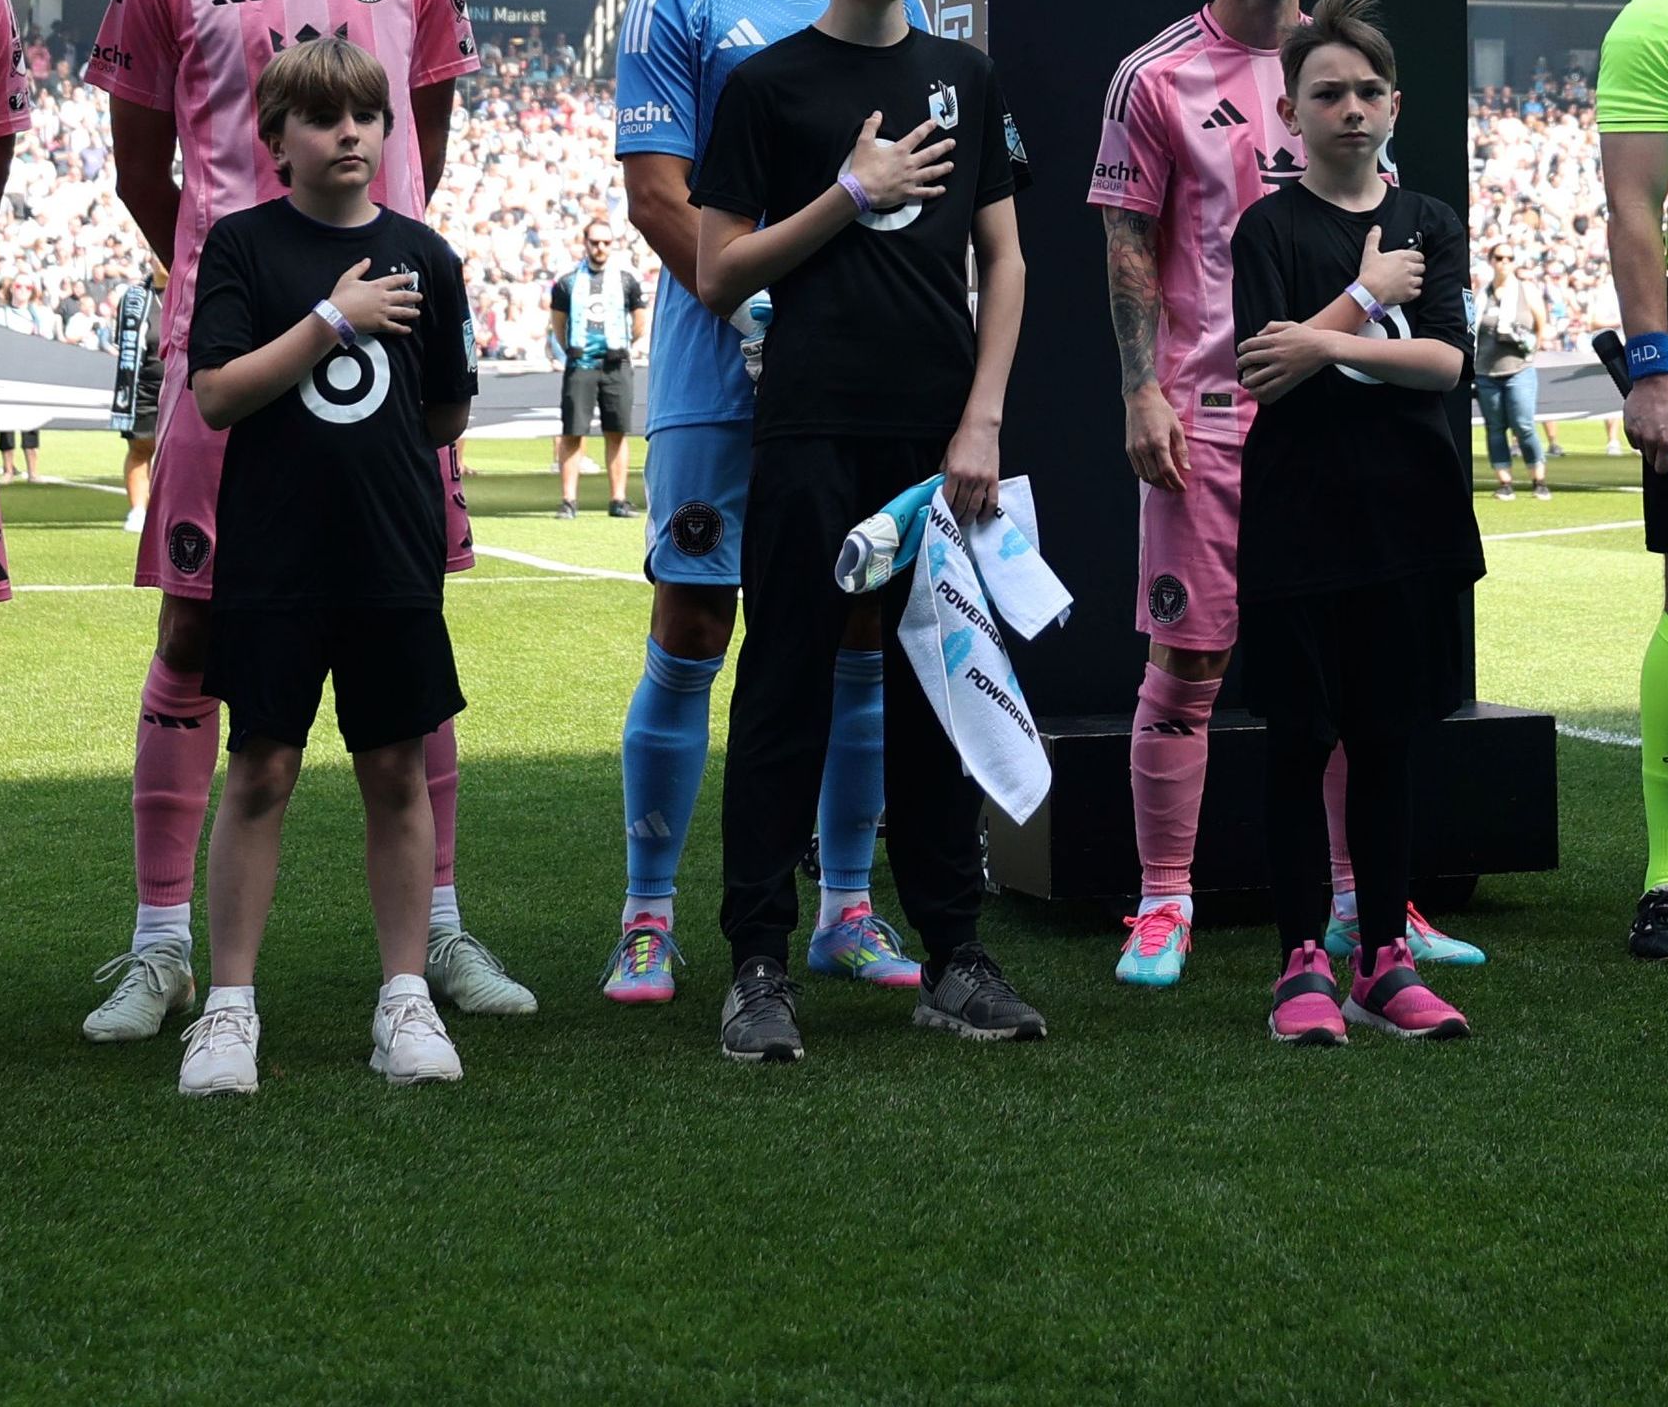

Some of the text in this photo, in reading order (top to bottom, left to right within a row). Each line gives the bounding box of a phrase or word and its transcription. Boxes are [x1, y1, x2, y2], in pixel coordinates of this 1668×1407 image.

[494, 7, 547, 23] Market
[619, 123, 653, 136] GROUP
[1095, 160, 1141, 184] acht
[1631, 344, 1661, 365] H.D.
[965, 666, 1036, 744] POWERADE
